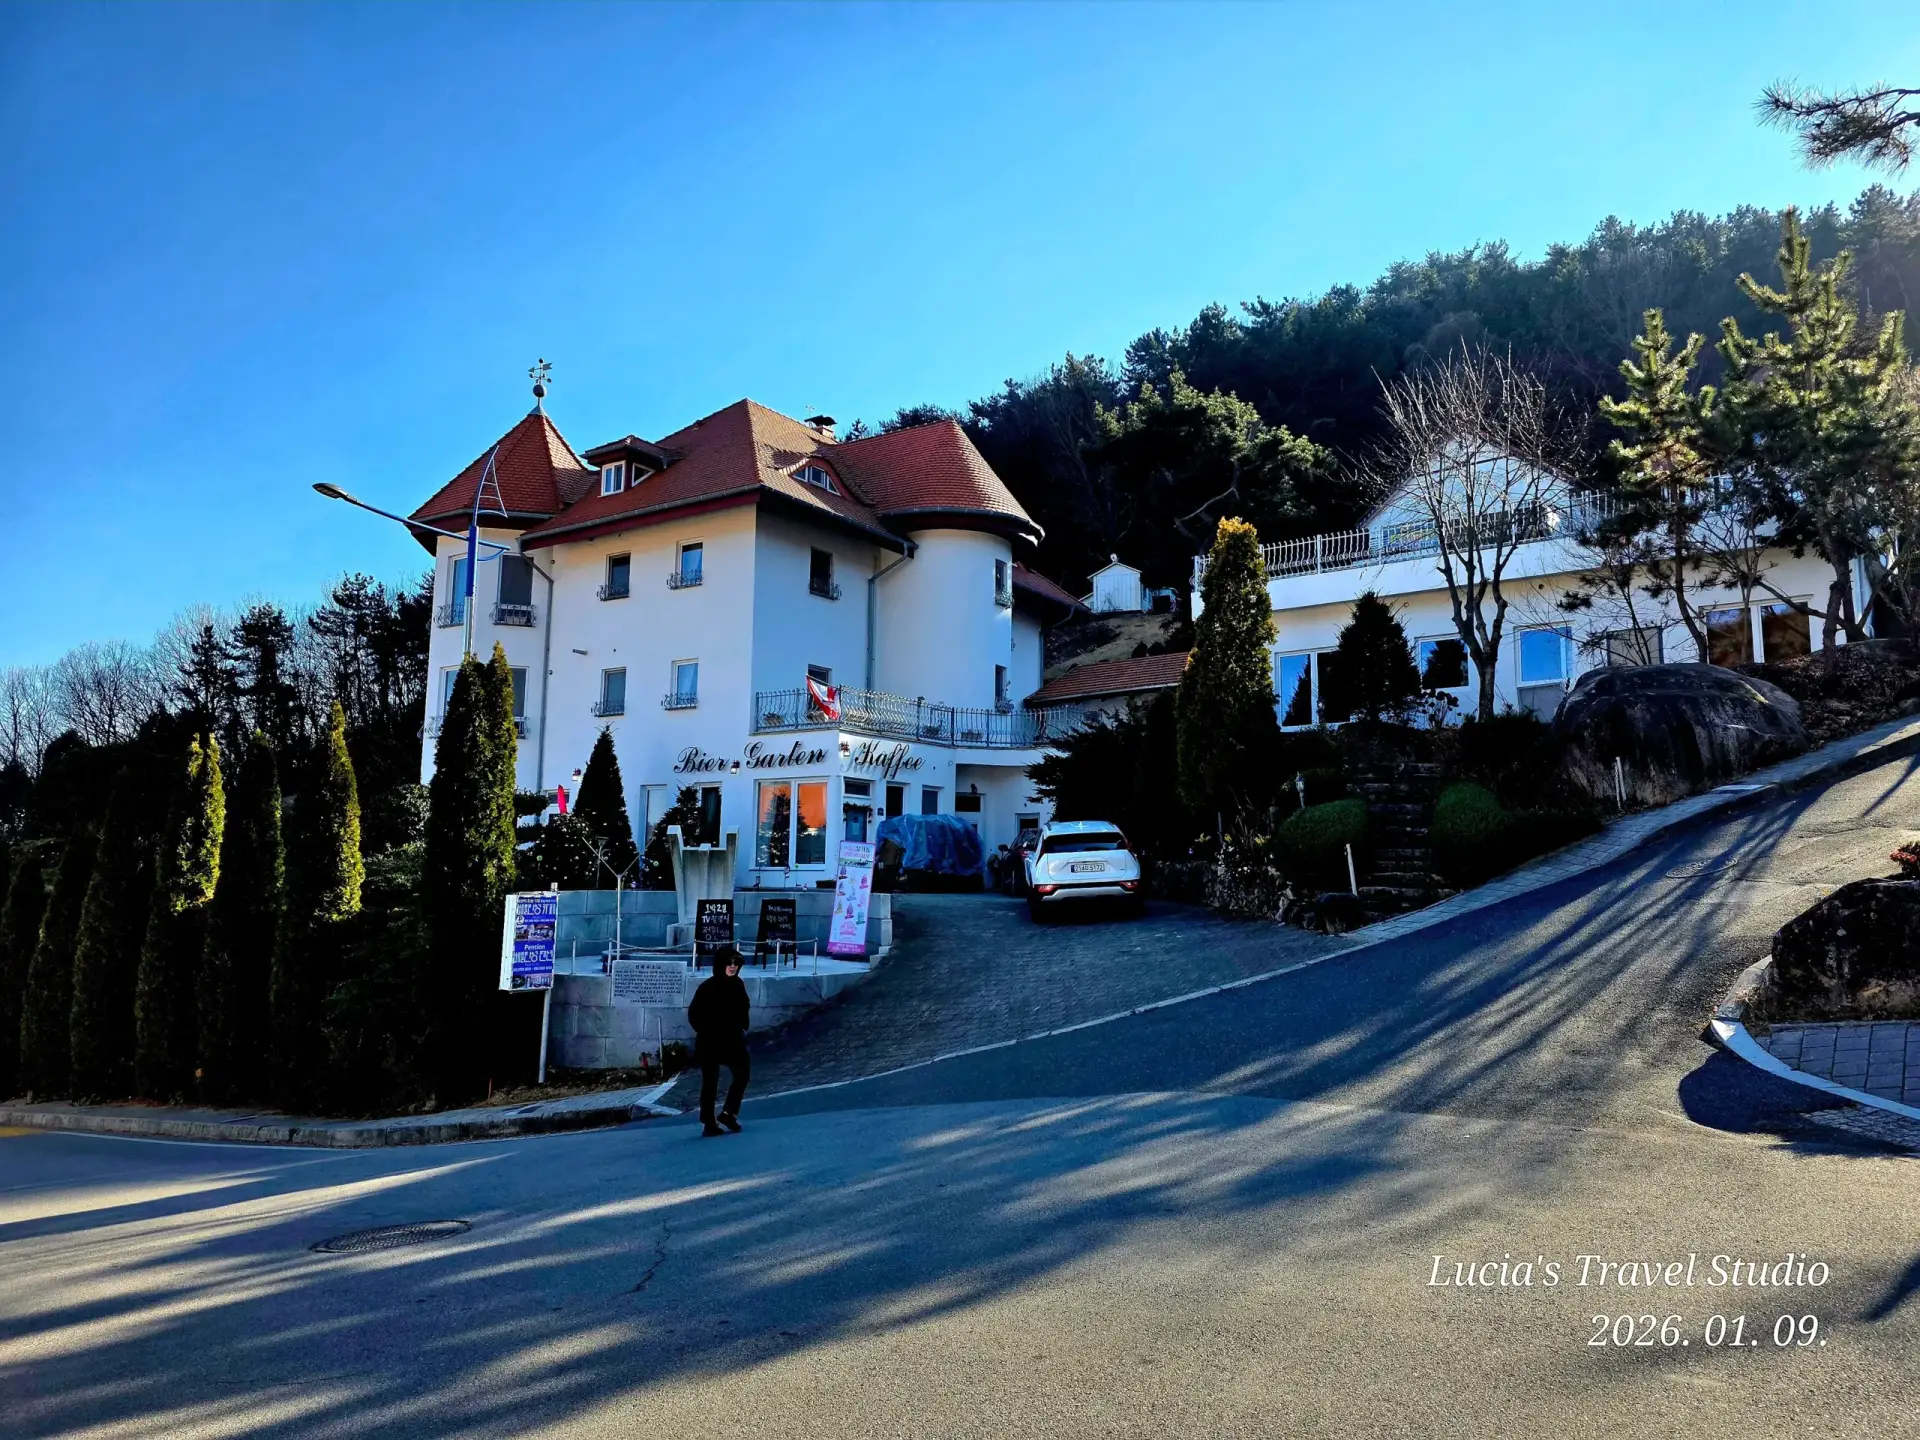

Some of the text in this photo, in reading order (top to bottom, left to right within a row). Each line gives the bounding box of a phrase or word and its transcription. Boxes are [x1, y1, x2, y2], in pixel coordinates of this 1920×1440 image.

[674, 740, 926, 779] Bier Garten Kaffee
[524, 943, 546, 951] Pension
